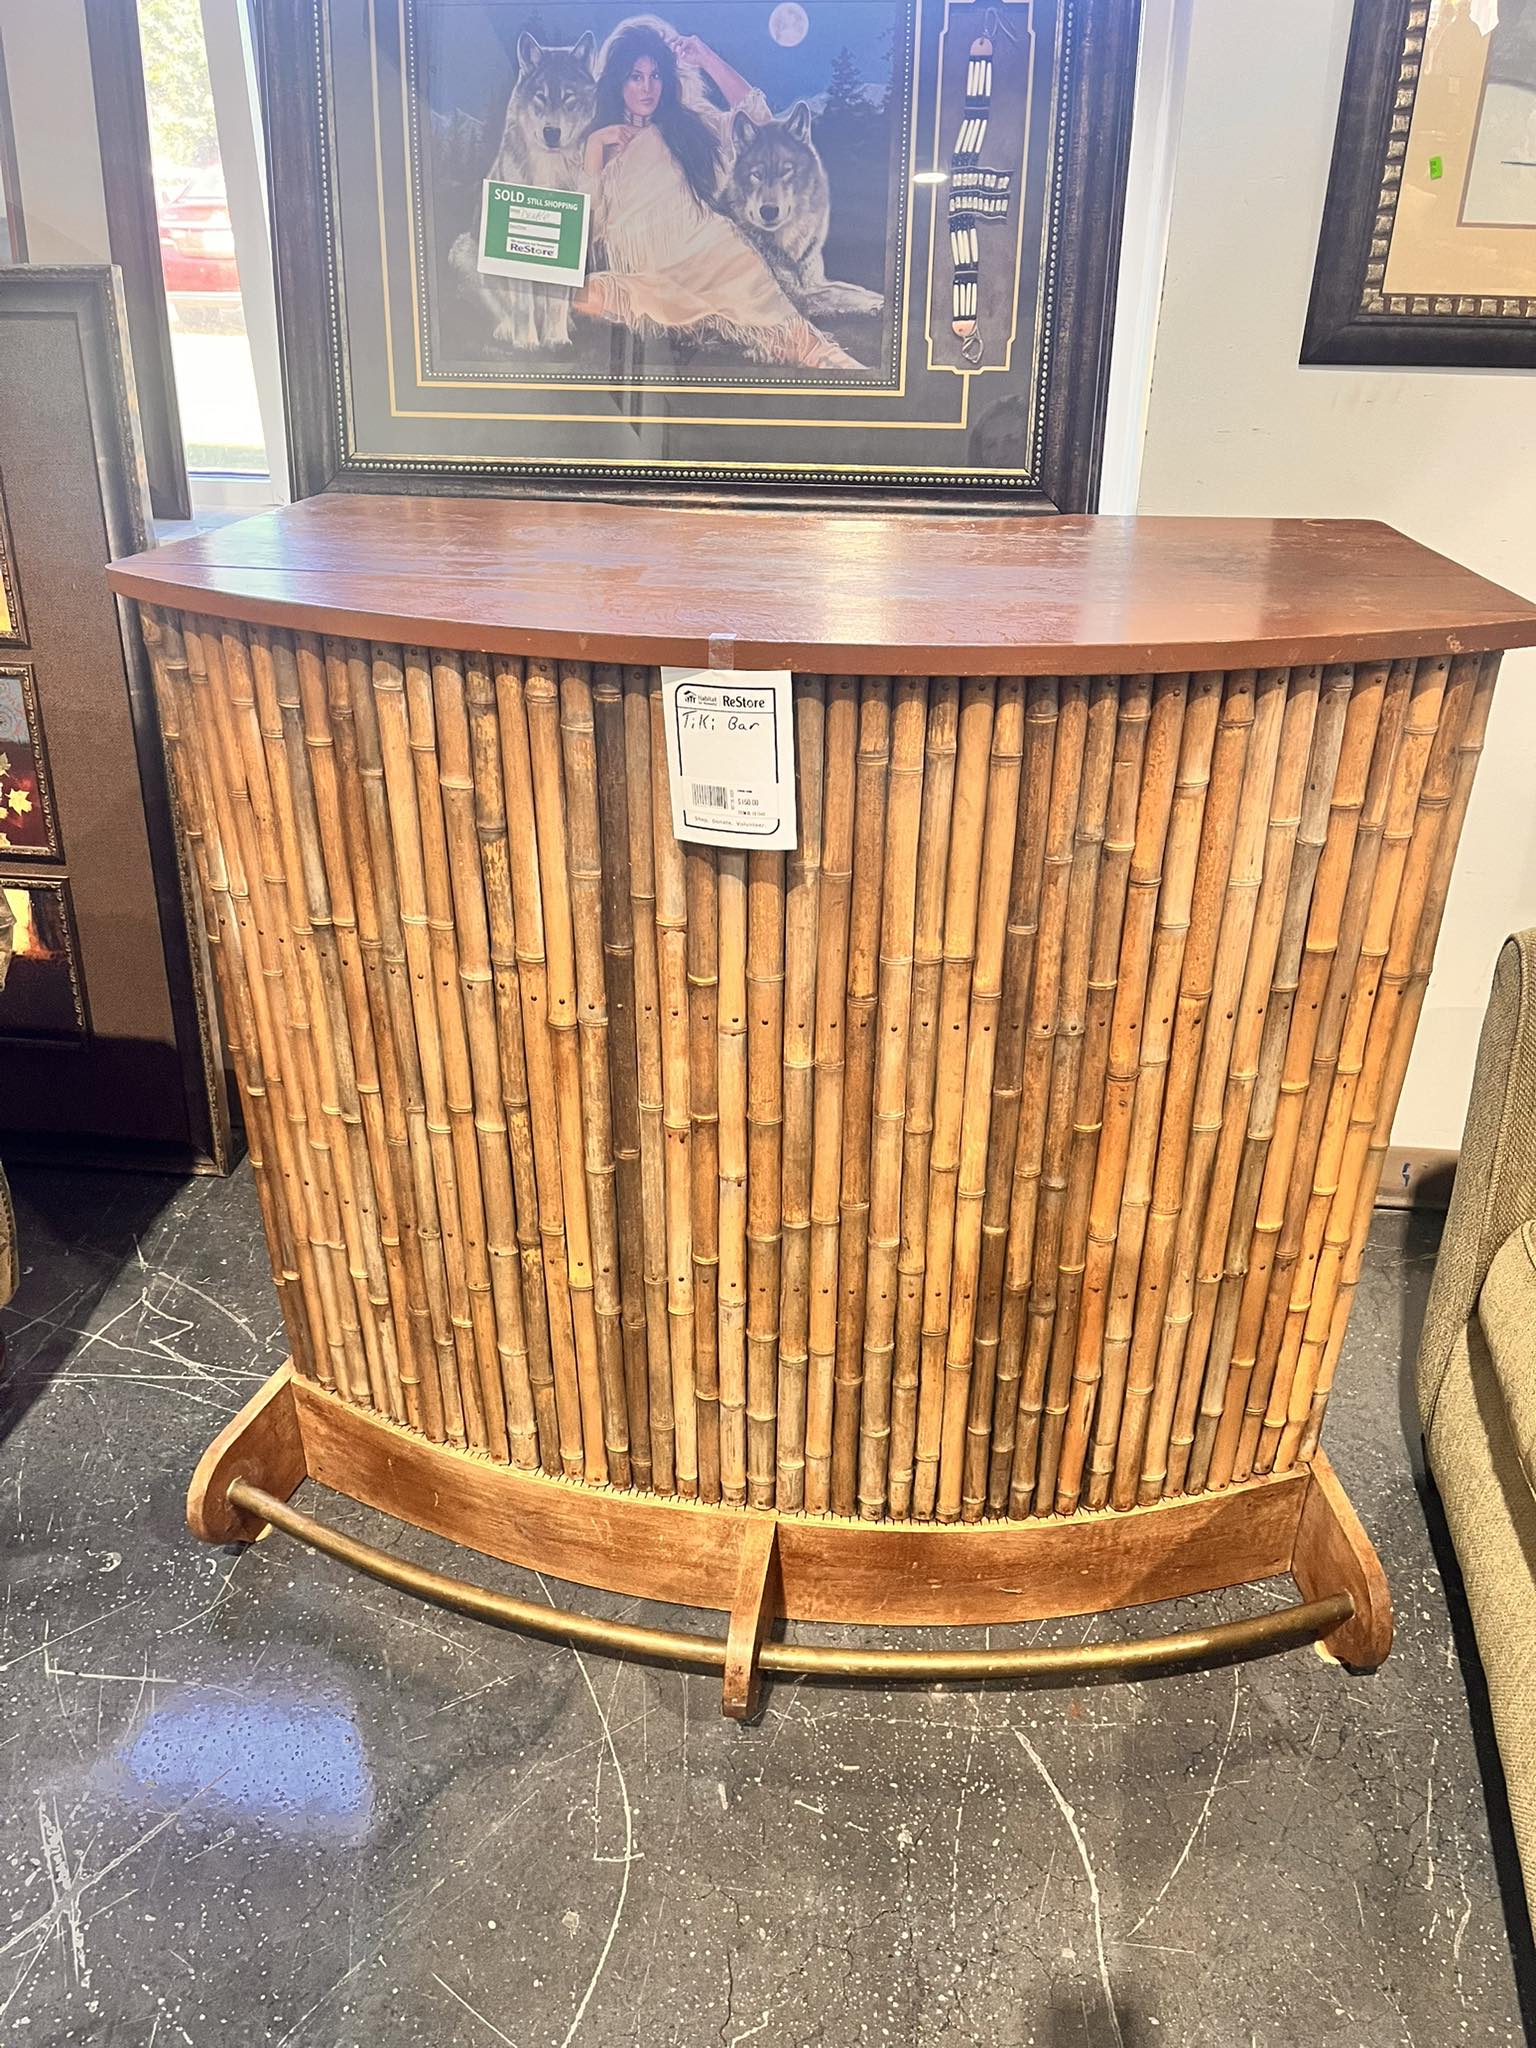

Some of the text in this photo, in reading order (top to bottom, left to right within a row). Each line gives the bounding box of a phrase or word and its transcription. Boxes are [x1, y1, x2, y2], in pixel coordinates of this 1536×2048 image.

[495, 188, 578, 211] SOLD STILL SHOPPING
[511, 243, 554, 256] ReStore
[723, 696, 765, 708] ReStore
[728, 716, 759, 730] Bar
